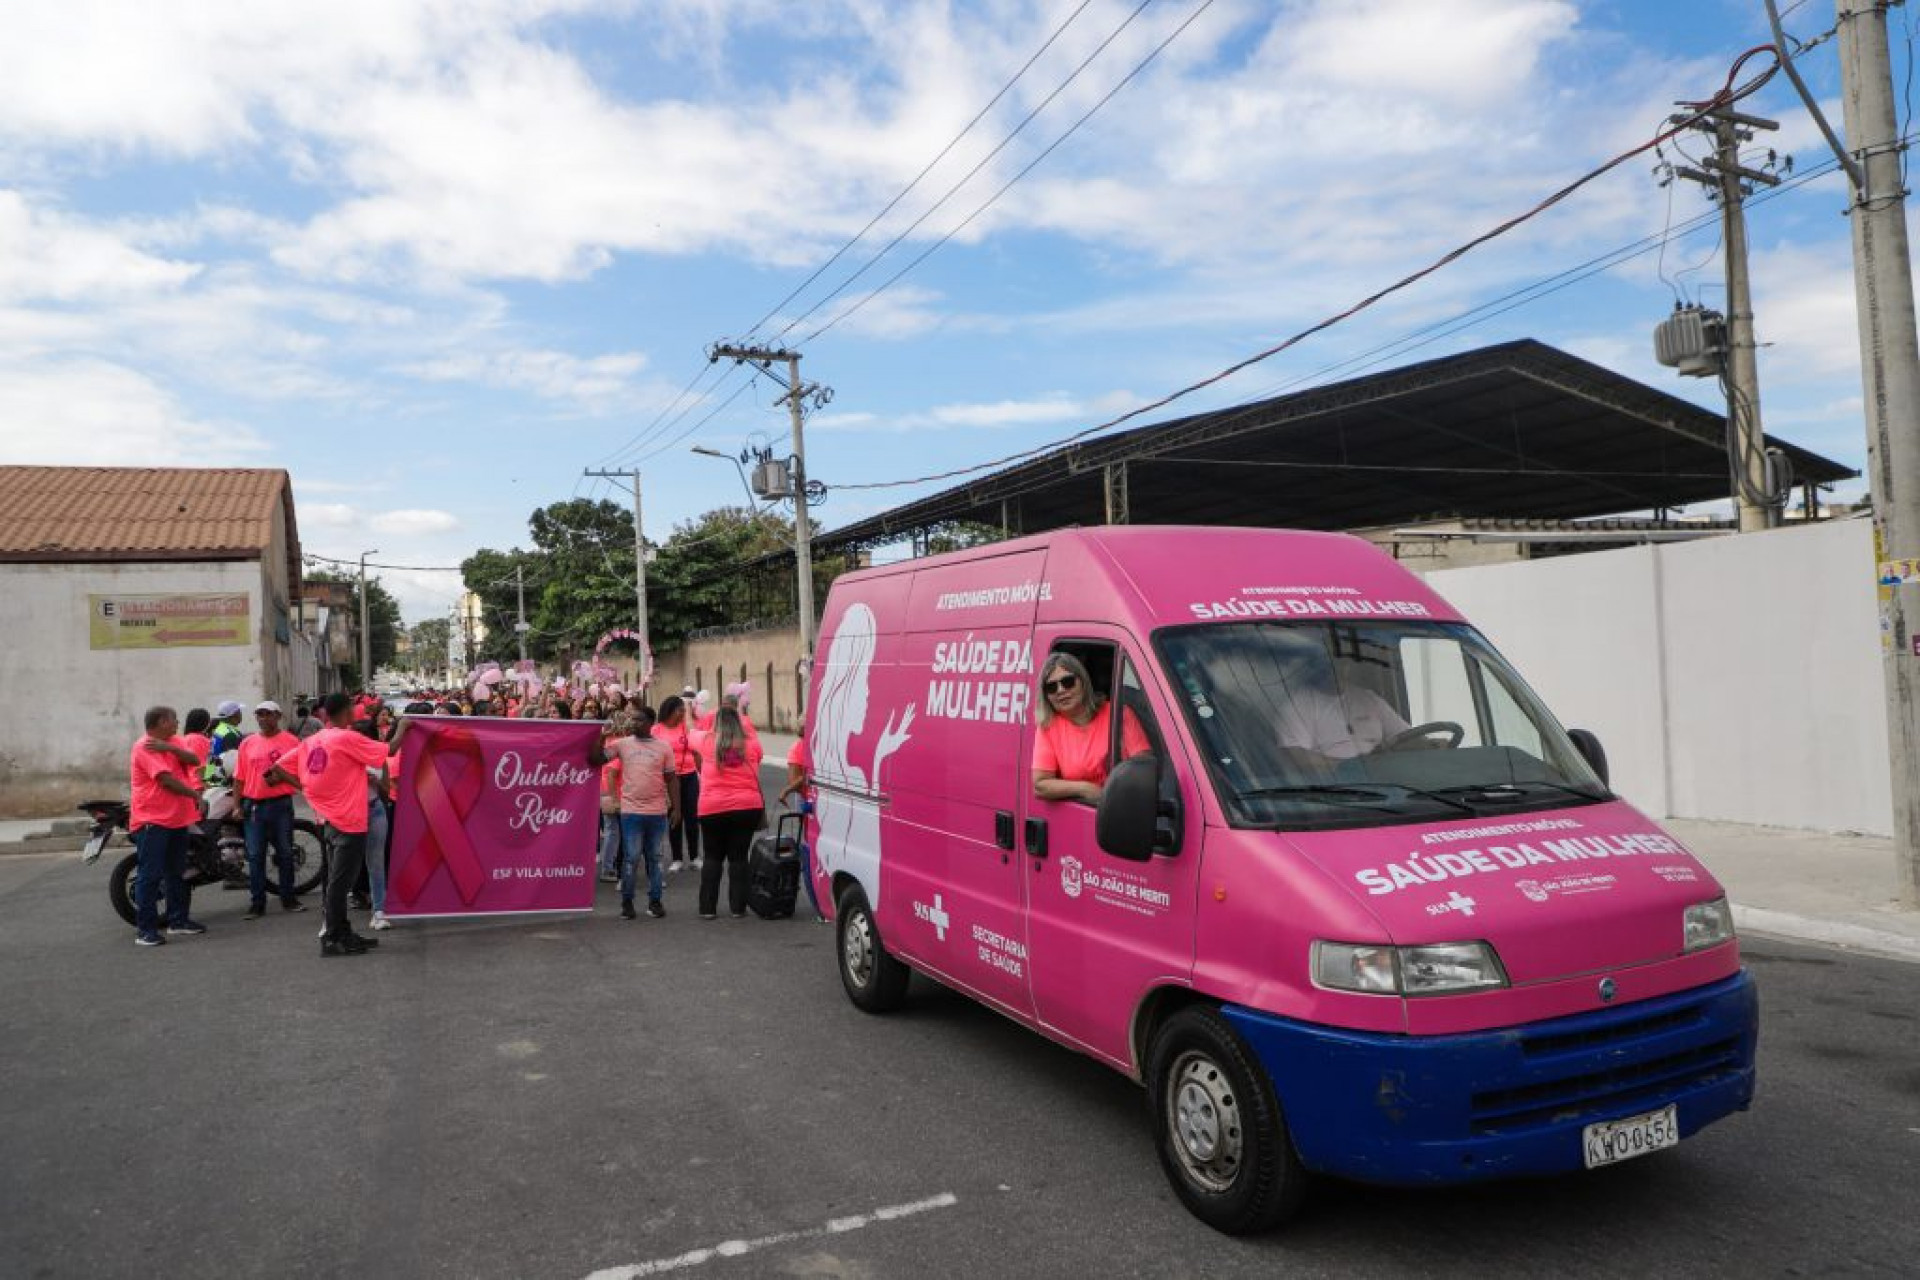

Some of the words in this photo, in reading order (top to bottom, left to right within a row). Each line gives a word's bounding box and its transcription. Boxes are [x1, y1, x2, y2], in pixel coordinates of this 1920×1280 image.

[936, 588, 1009, 611] ATENDIMENTO
[1010, 580, 1052, 604] MÓVEL
[1189, 597, 1288, 619] SAÚDE
[1288, 599, 1328, 615] DA
[1325, 599, 1431, 617] MULHER
[932, 632, 1001, 674] SAÚDE
[1002, 639, 1033, 674] DA
[926, 680, 1030, 724] MULHER
[494, 751, 593, 790] Outubro
[509, 792, 573, 833] Rosa
[1421, 824, 1530, 844] ATENDIMENTO
[1527, 818, 1584, 832] MÓVEL
[492, 867, 513, 879] ESF
[515, 867, 543, 878] VILA
[545, 864, 585, 878] UNIÃO
[1355, 851, 1500, 895] SAÚDE
[1487, 843, 1556, 869] DA
[1542, 834, 1687, 861] MULHER
[1083, 870, 1100, 888] SÃO
[1101, 876, 1124, 893] JOÃO
[1126, 883, 1138, 899] DE
[1139, 887, 1171, 907] MERITI
[913, 900, 930, 921] SUS
[973, 924, 1027, 959] SECRETARIA
[979, 944, 991, 964] DE
[991, 951, 1023, 978] SAÚDE
